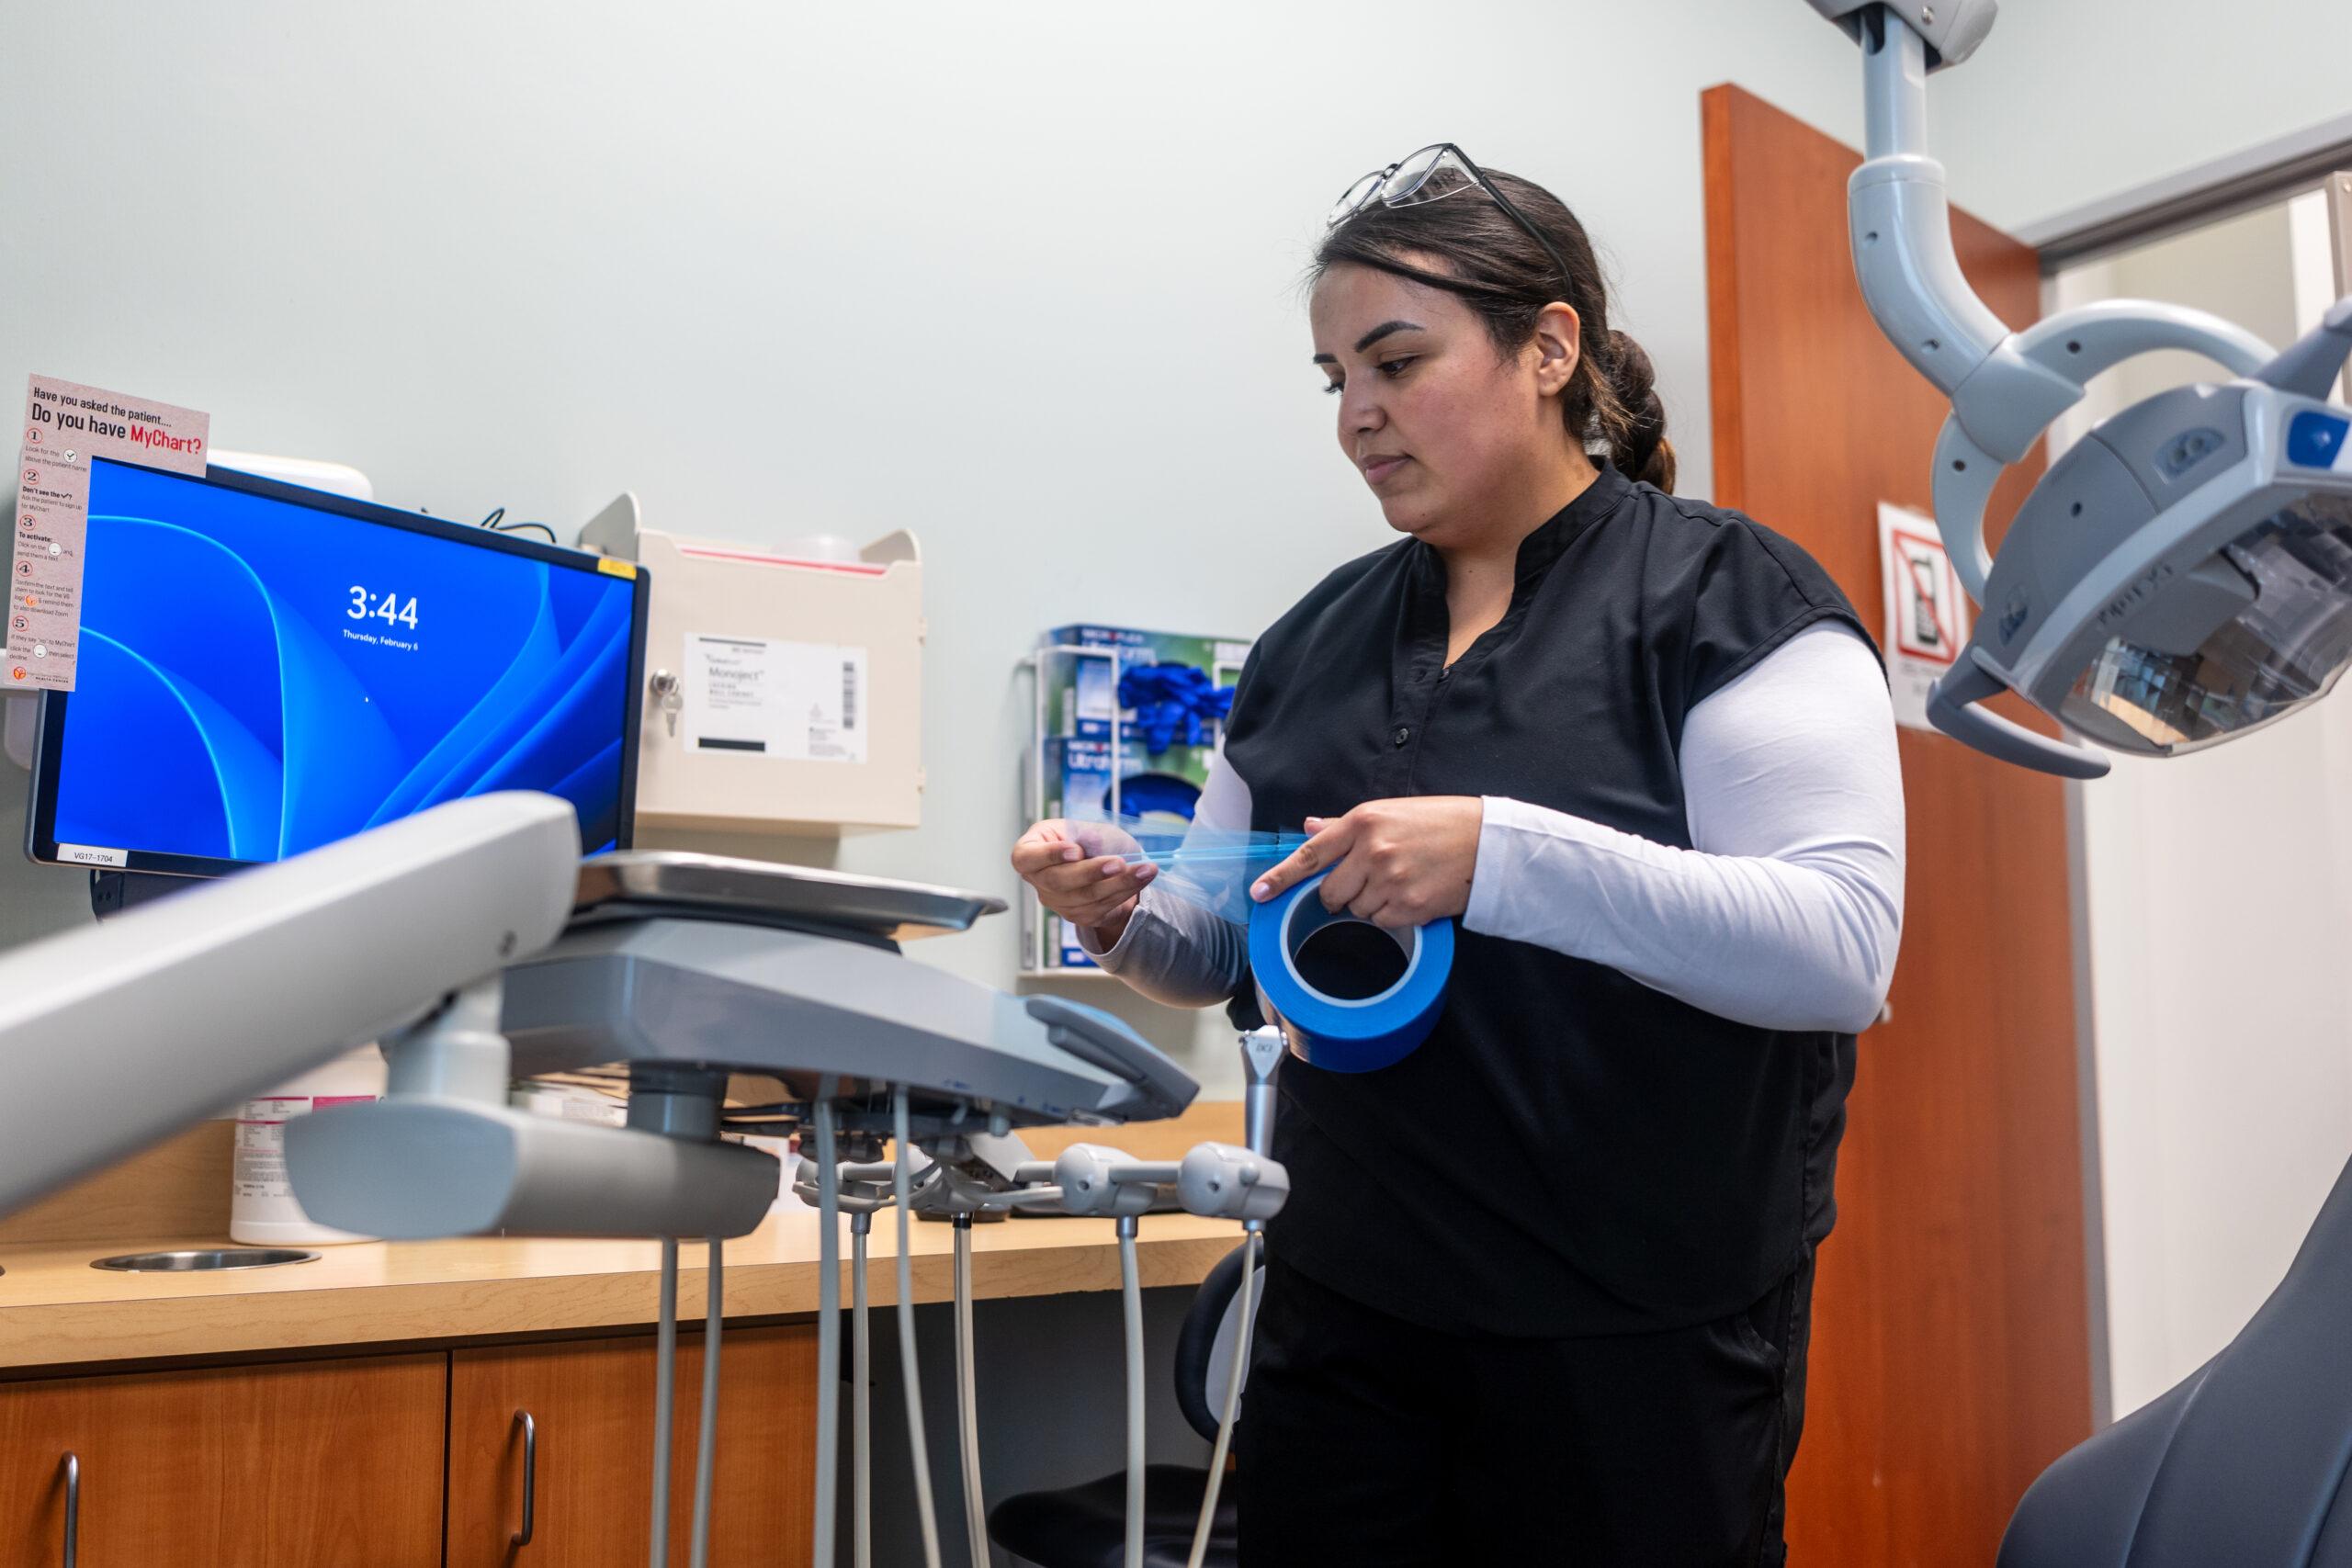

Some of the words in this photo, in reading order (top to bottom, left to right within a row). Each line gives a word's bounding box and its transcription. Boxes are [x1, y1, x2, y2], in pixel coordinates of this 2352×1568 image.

[34, 387, 57, 401] Have
[61, 395, 77, 407] you
[80, 399, 108, 412] asked
[111, 404, 125, 417] the
[32, 403, 51, 423] Do
[57, 411, 85, 430] you
[89, 415, 126, 439] have
[130, 424, 202, 455] MyChart?
[23, 485, 38, 494] Don't
[29, 504, 49, 513] MyChart
[347, 585, 418, 630] 3:44
[55, 639, 75, 648] MyChart
[343, 629, 379, 645] Thursday,
[380, 636, 412, 652] February
[413, 642, 418, 651] 6
[74, 852, 113, 862] VG17-1704
